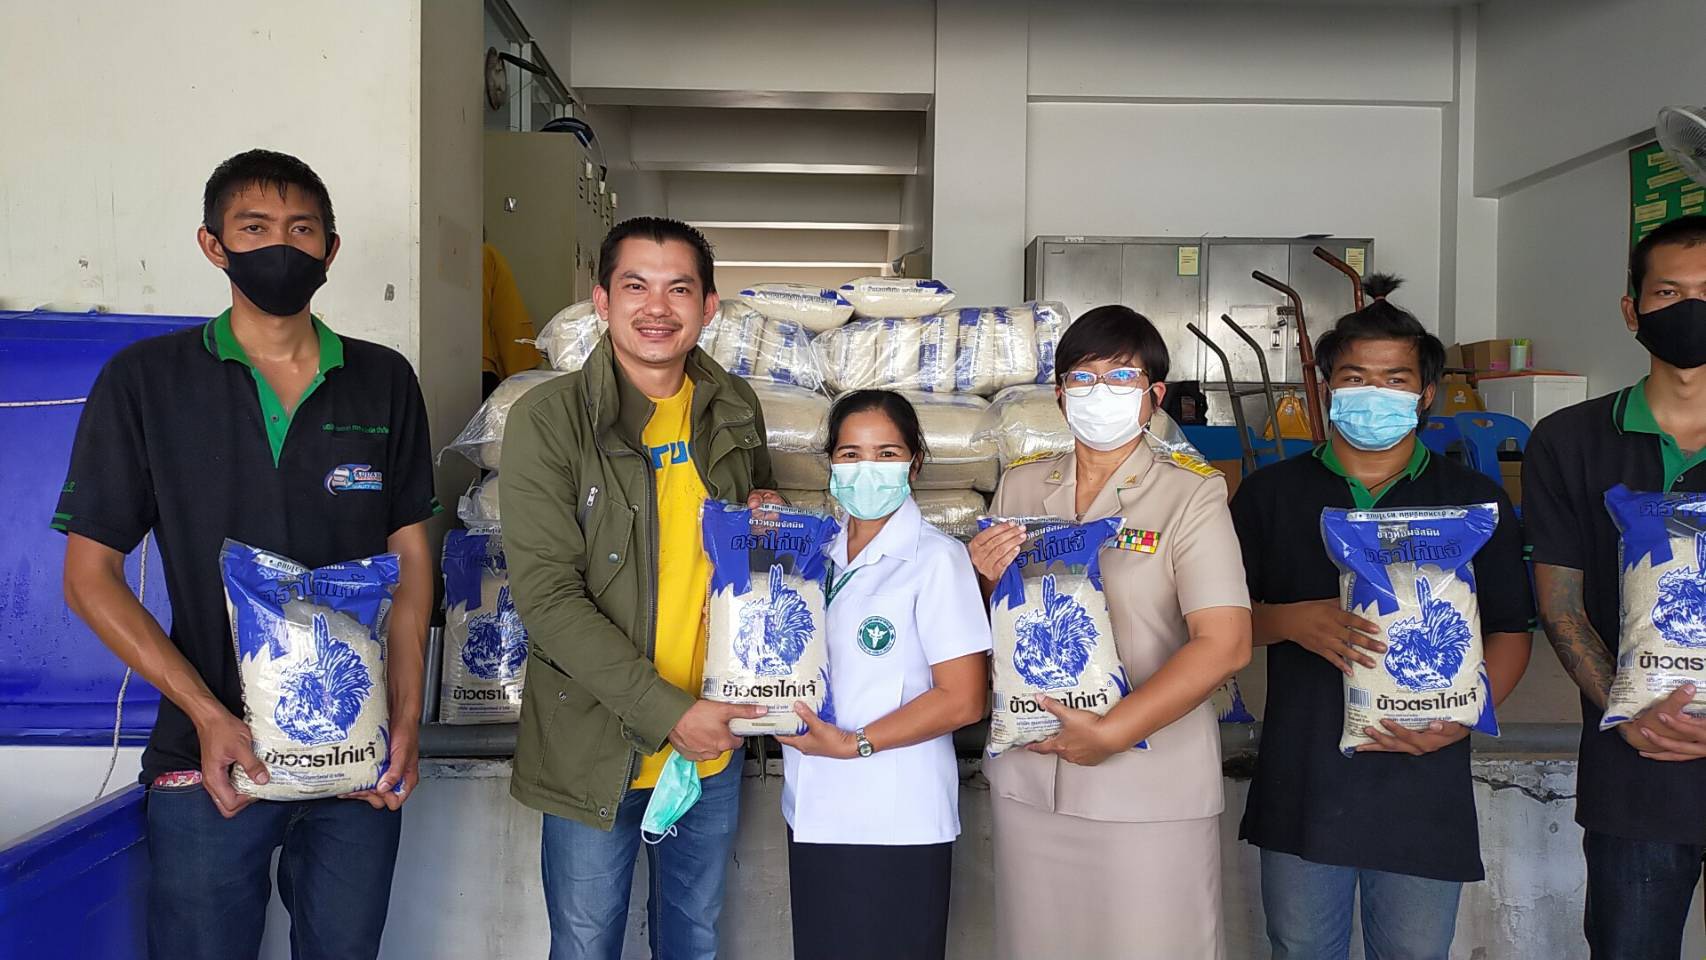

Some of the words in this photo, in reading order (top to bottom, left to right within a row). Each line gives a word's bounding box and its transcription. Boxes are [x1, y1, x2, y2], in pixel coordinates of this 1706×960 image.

[748, 518, 804, 529] ข้าวหอมจัสมิน
[731, 530, 815, 556] ตราไก่แจ้
[1364, 538, 1462, 565] ตราไก่แจ้
[722, 679, 817, 698] ข้าวตราไก่แจ้
[1376, 687, 1477, 711] ข้าวตราไก่แจ้
[264, 741, 376, 768] ข้าวตราไก่แจ้
